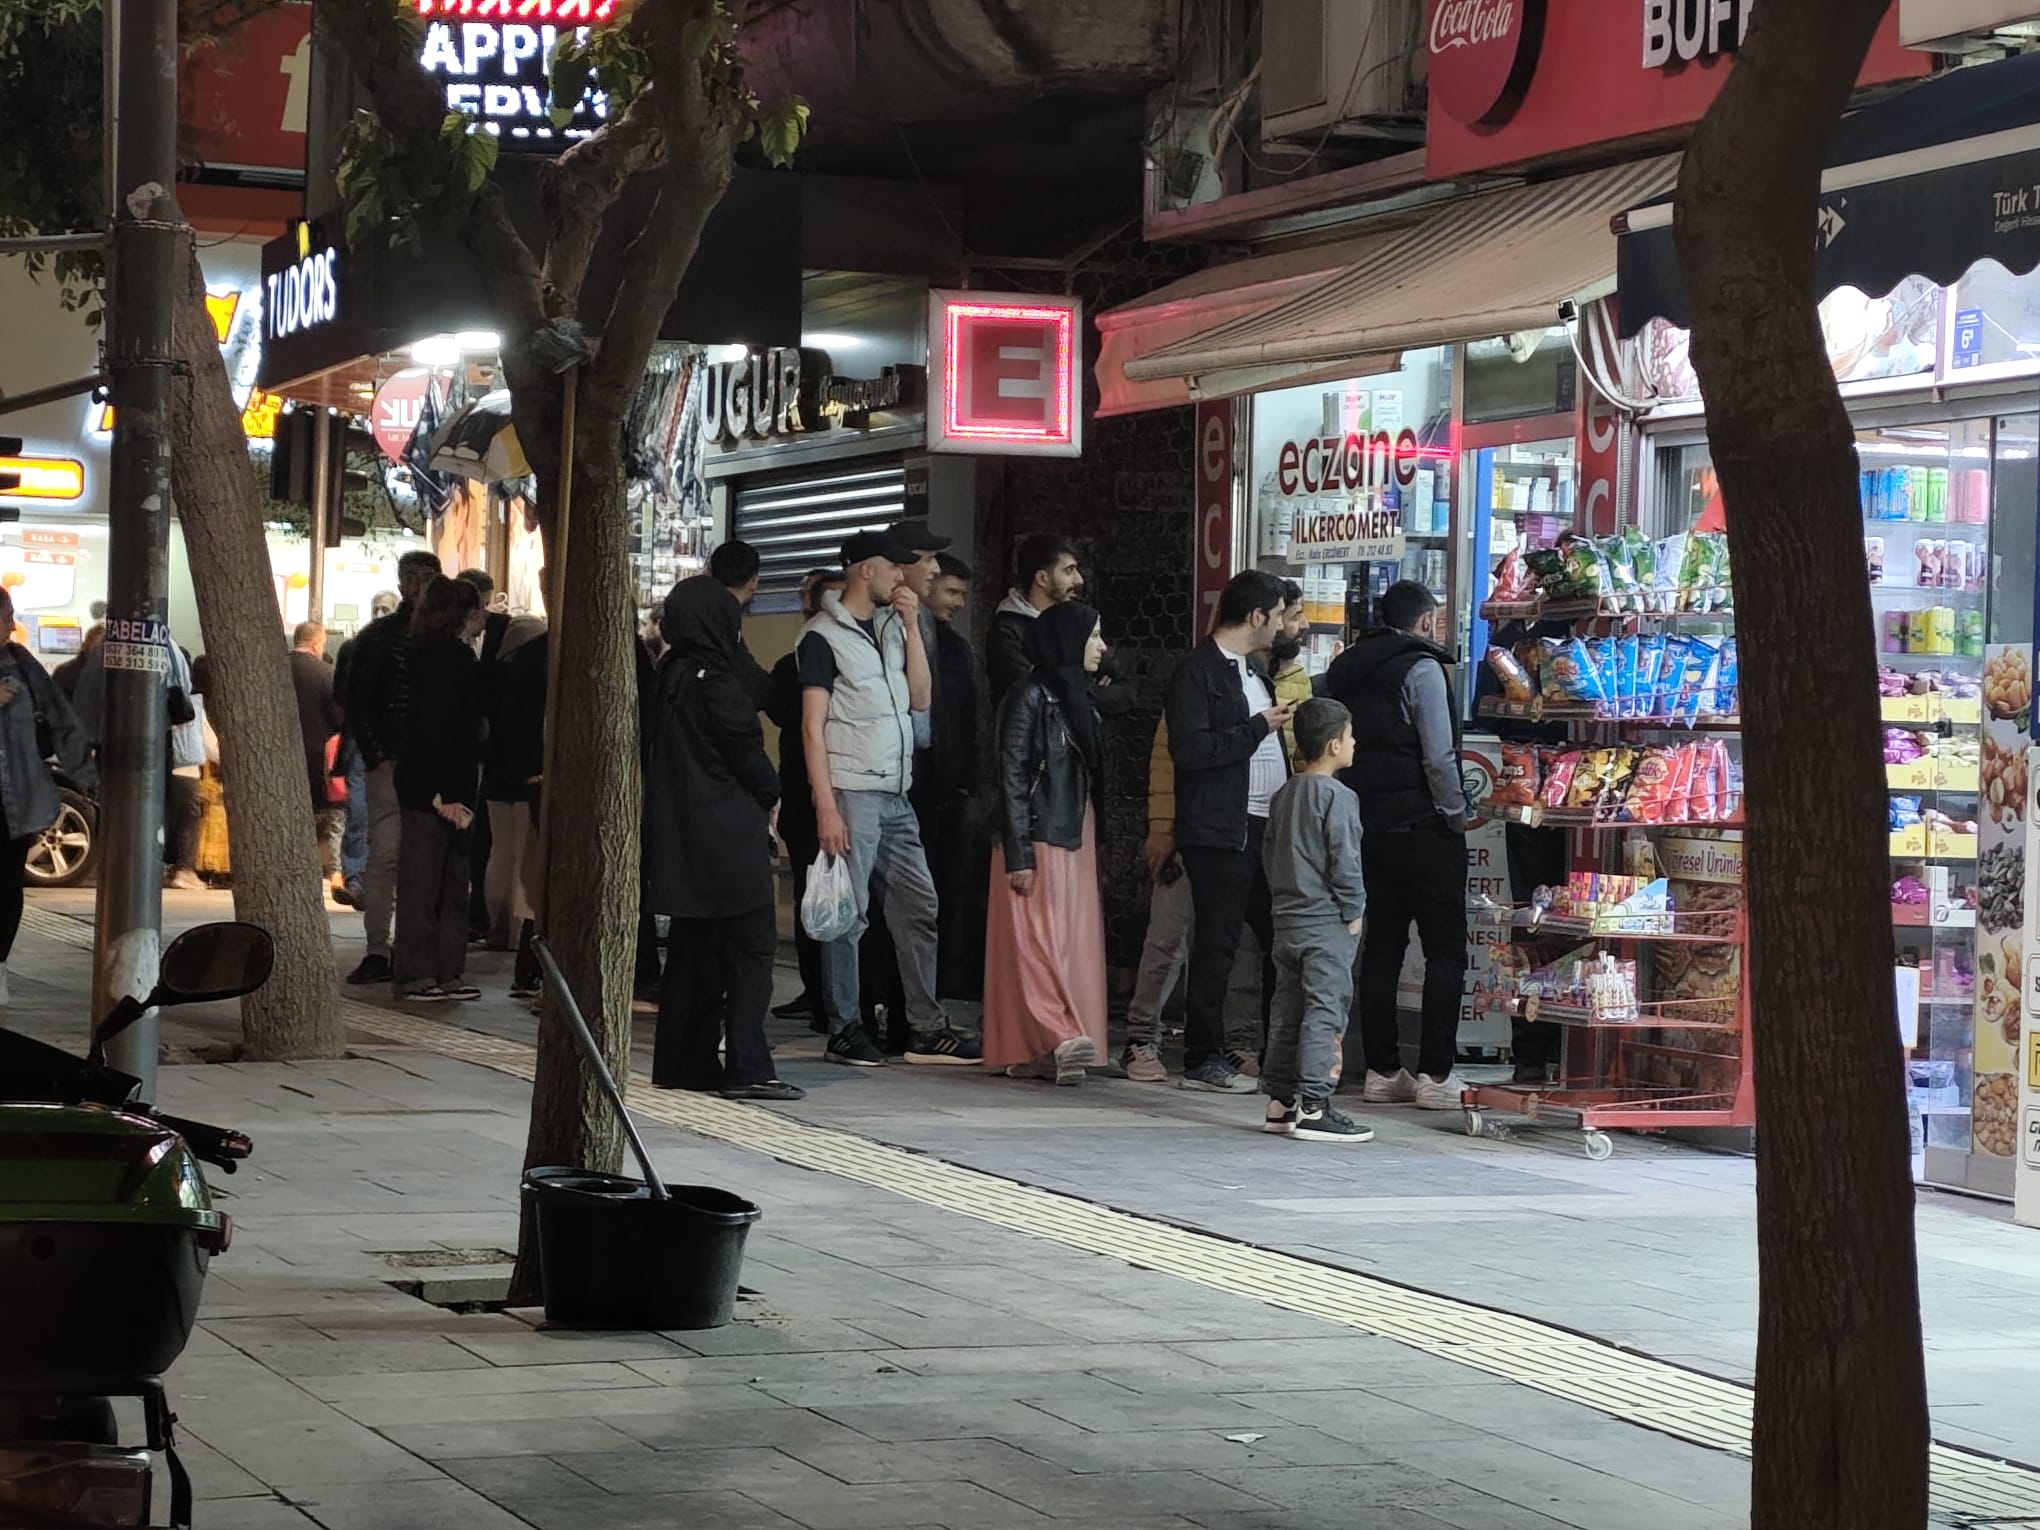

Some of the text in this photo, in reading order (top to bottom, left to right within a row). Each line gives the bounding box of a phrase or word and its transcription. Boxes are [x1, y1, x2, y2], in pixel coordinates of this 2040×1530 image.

[1993, 187, 2029, 217] Türk
[268, 246, 336, 340] TUDORS
[1278, 427, 1417, 497] eczane
